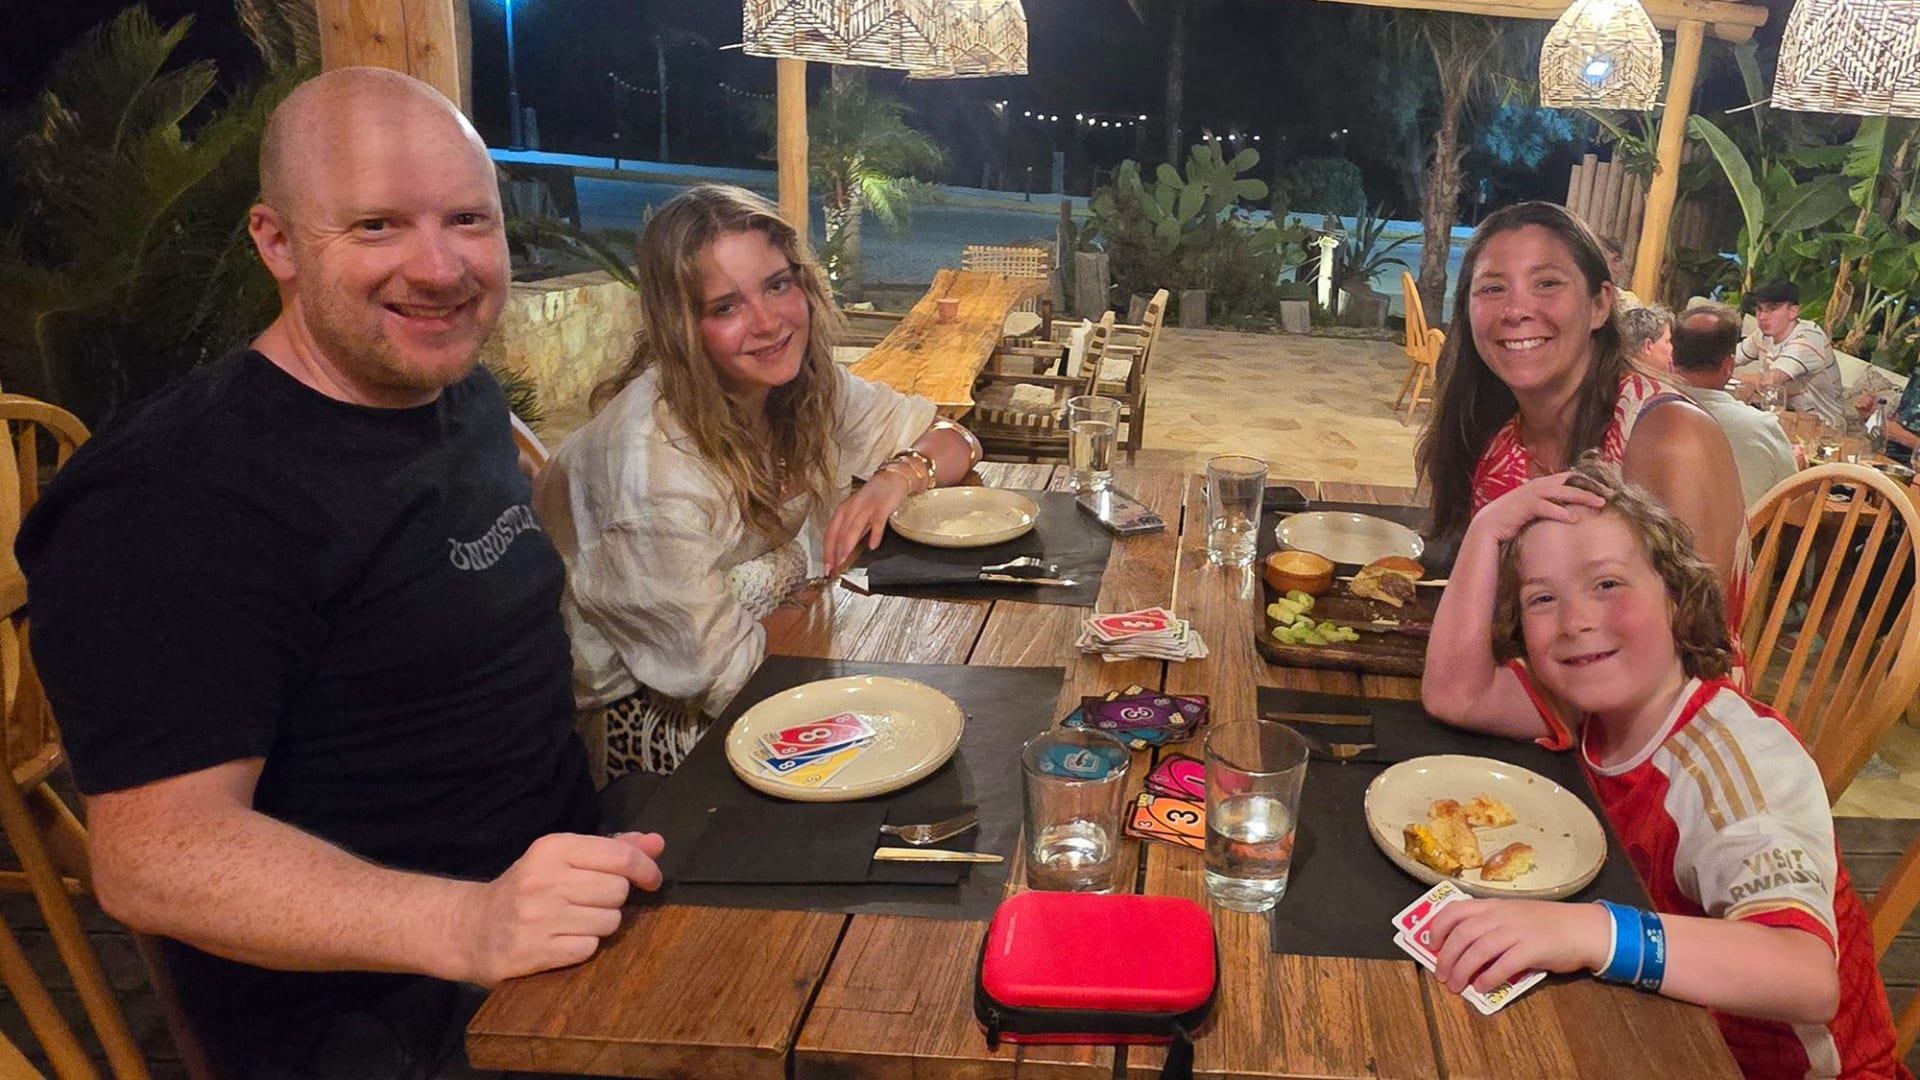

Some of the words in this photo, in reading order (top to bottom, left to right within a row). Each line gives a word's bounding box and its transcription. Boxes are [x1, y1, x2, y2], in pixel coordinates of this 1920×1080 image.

[836, 715, 850, 723] 8
[1121, 706, 1153, 721] 3
[798, 728, 833, 742] 8
[778, 760, 796, 770] 8
[1137, 820, 1153, 828] 3
[1166, 809, 1199, 825] 3
[1742, 848, 1803, 876] VISIT
